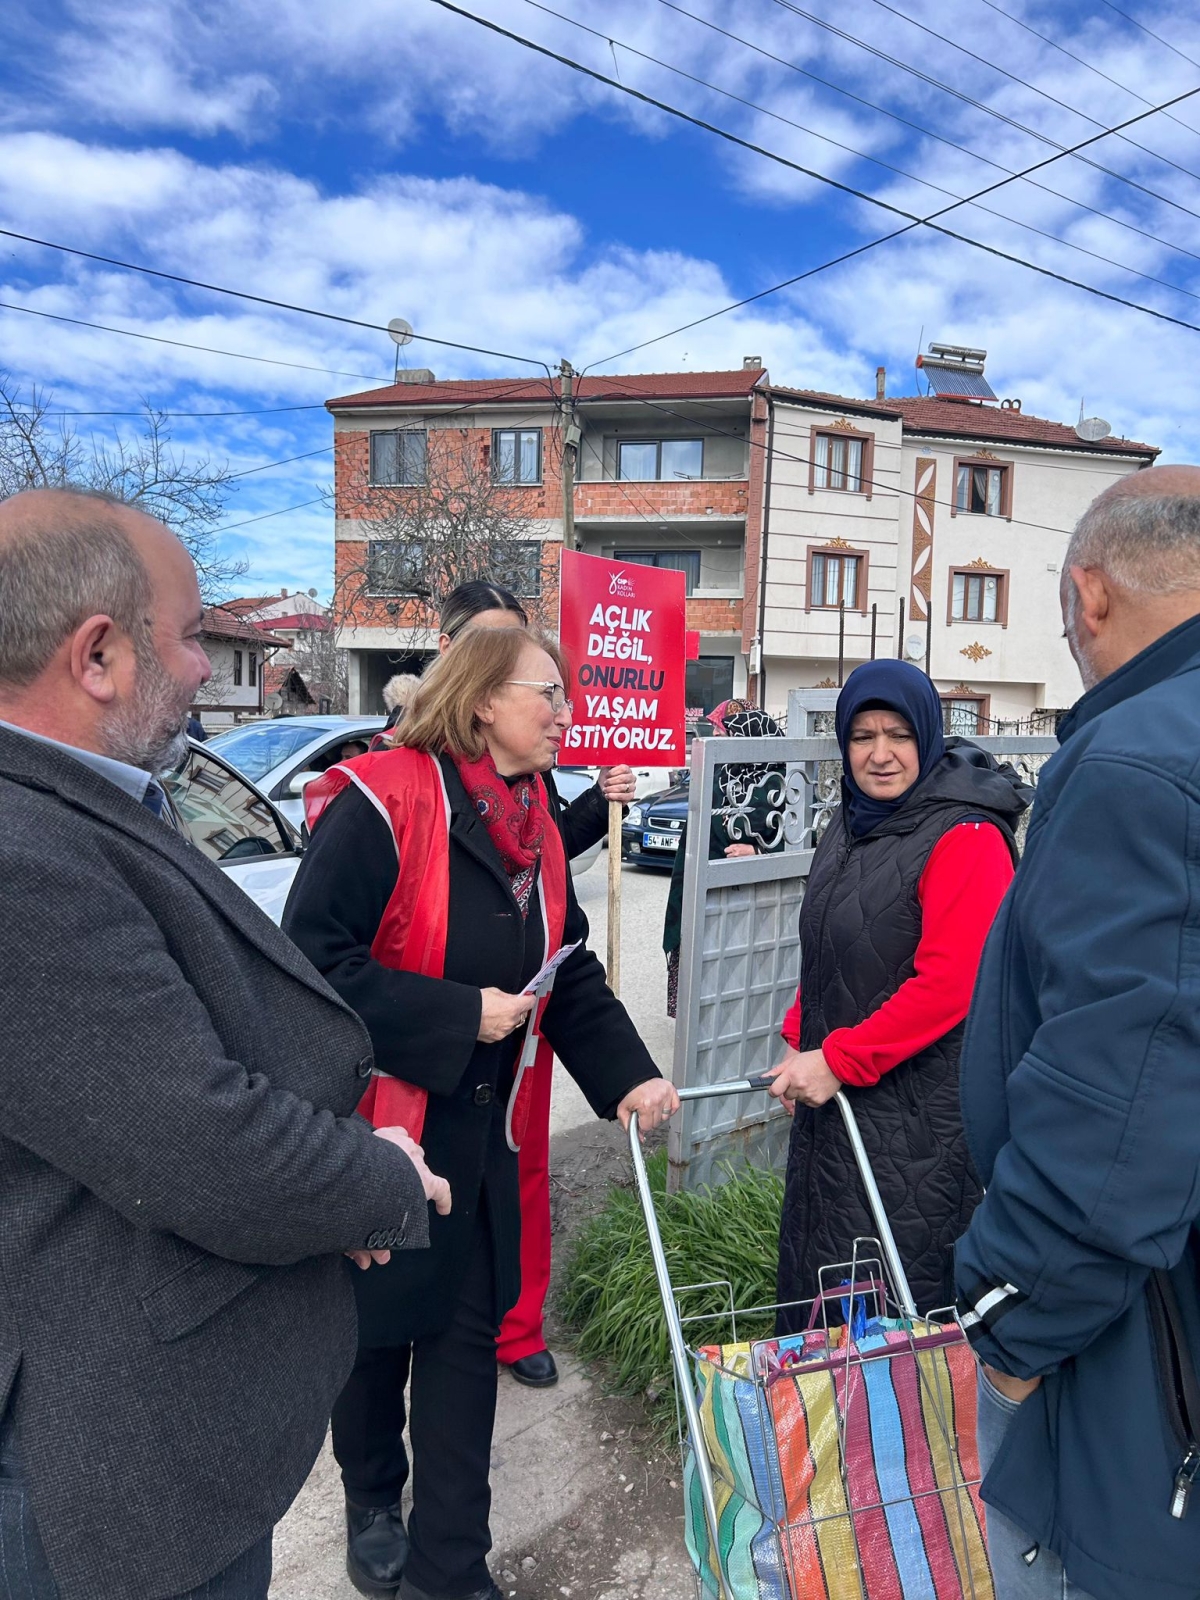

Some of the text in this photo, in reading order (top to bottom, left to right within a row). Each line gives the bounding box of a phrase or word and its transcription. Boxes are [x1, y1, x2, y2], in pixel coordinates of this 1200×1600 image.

[589, 603, 652, 634] AÇLIK
[587, 631, 653, 665] DEĞİL,
[578, 664, 665, 691] ONURLU
[585, 695, 658, 725] YAŞAM
[564, 725, 676, 750] İSTİYORUZ.
[648, 835, 656, 845] 54
